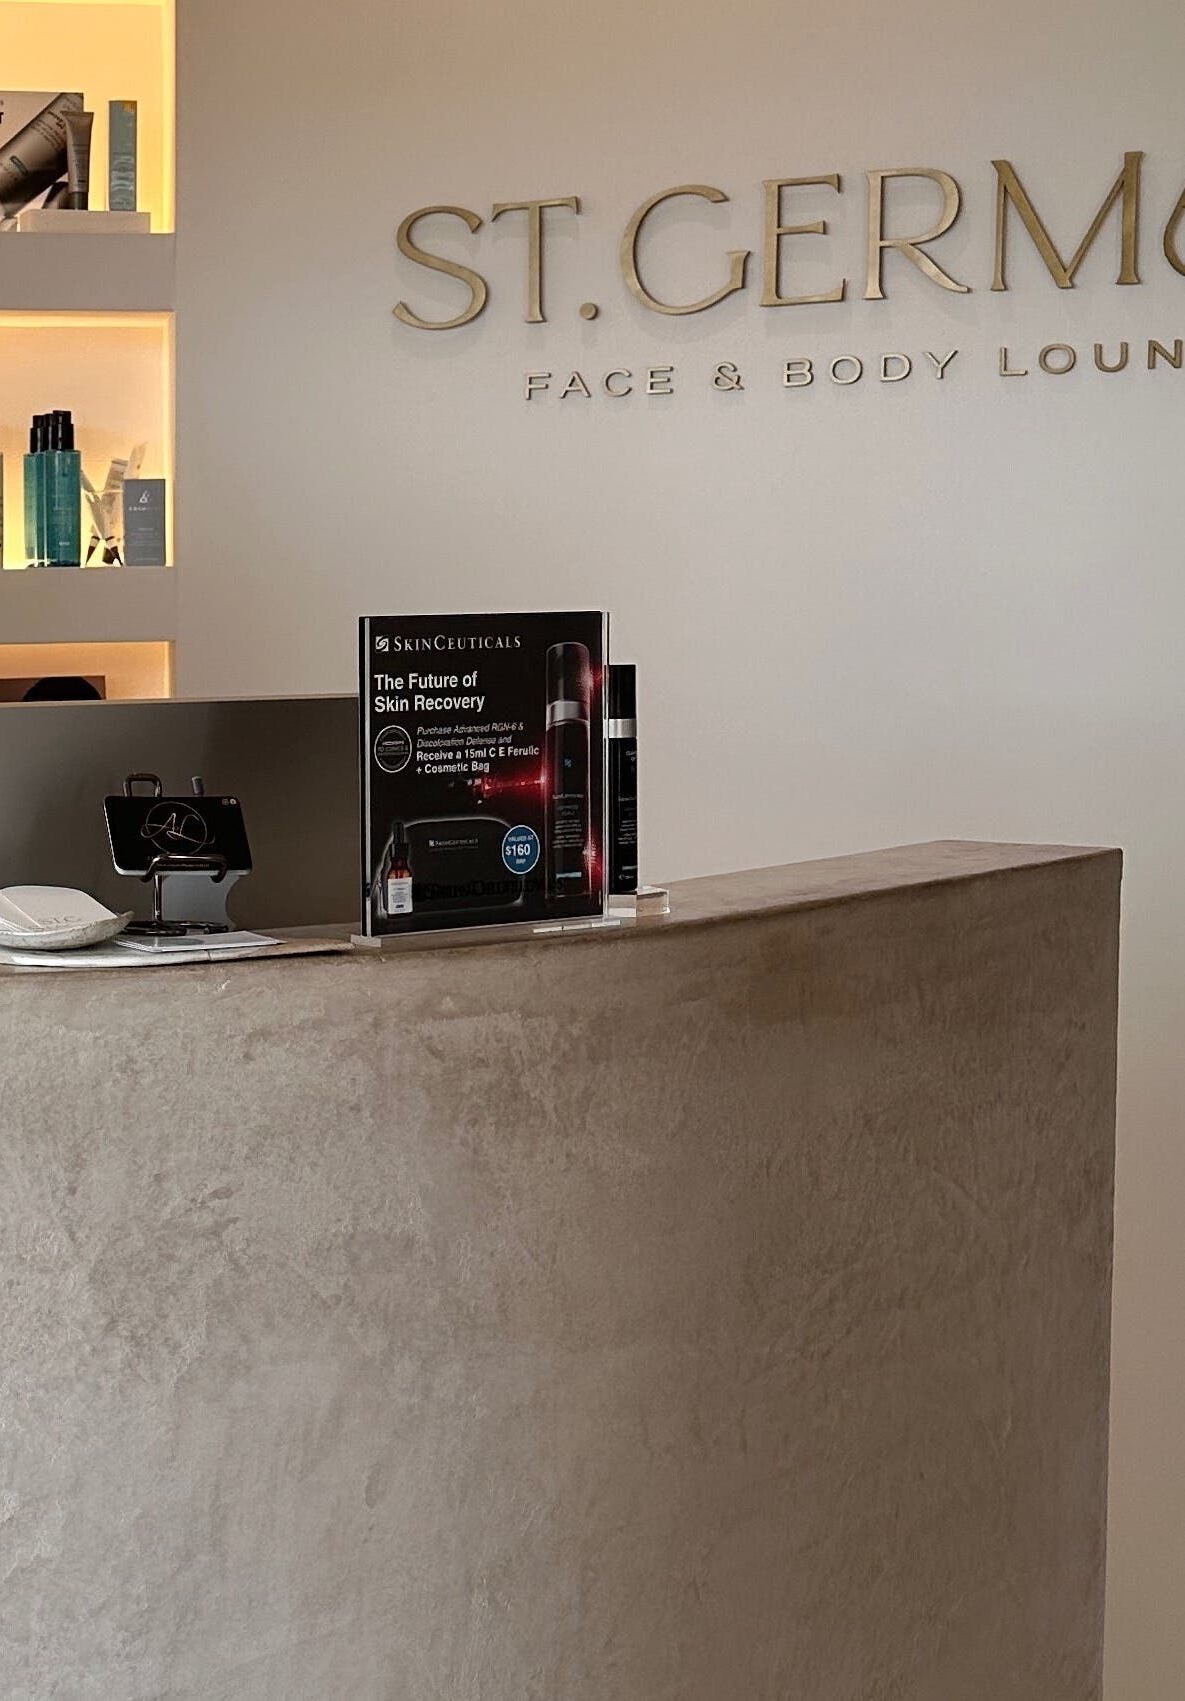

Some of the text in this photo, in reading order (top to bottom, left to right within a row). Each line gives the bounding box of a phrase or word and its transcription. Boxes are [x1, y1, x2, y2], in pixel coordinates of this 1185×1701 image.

[392, 150, 1185, 331] ST.GERM
[524, 339, 1183, 401] FACE & BODY LOUN
[393, 634, 521, 651] SKINCEUTICALS
[374, 670, 478, 690] The Future of
[374, 694, 486, 712] Skin Recovery
[416, 726, 452, 735] Purchase
[498, 735, 513, 744] and
[416, 745, 540, 761] Receive a 15ml C E Ferulic
[424, 762, 469, 774] Cosmetic
[471, 760, 490, 773] Bag
[505, 843, 531, 856] $160
